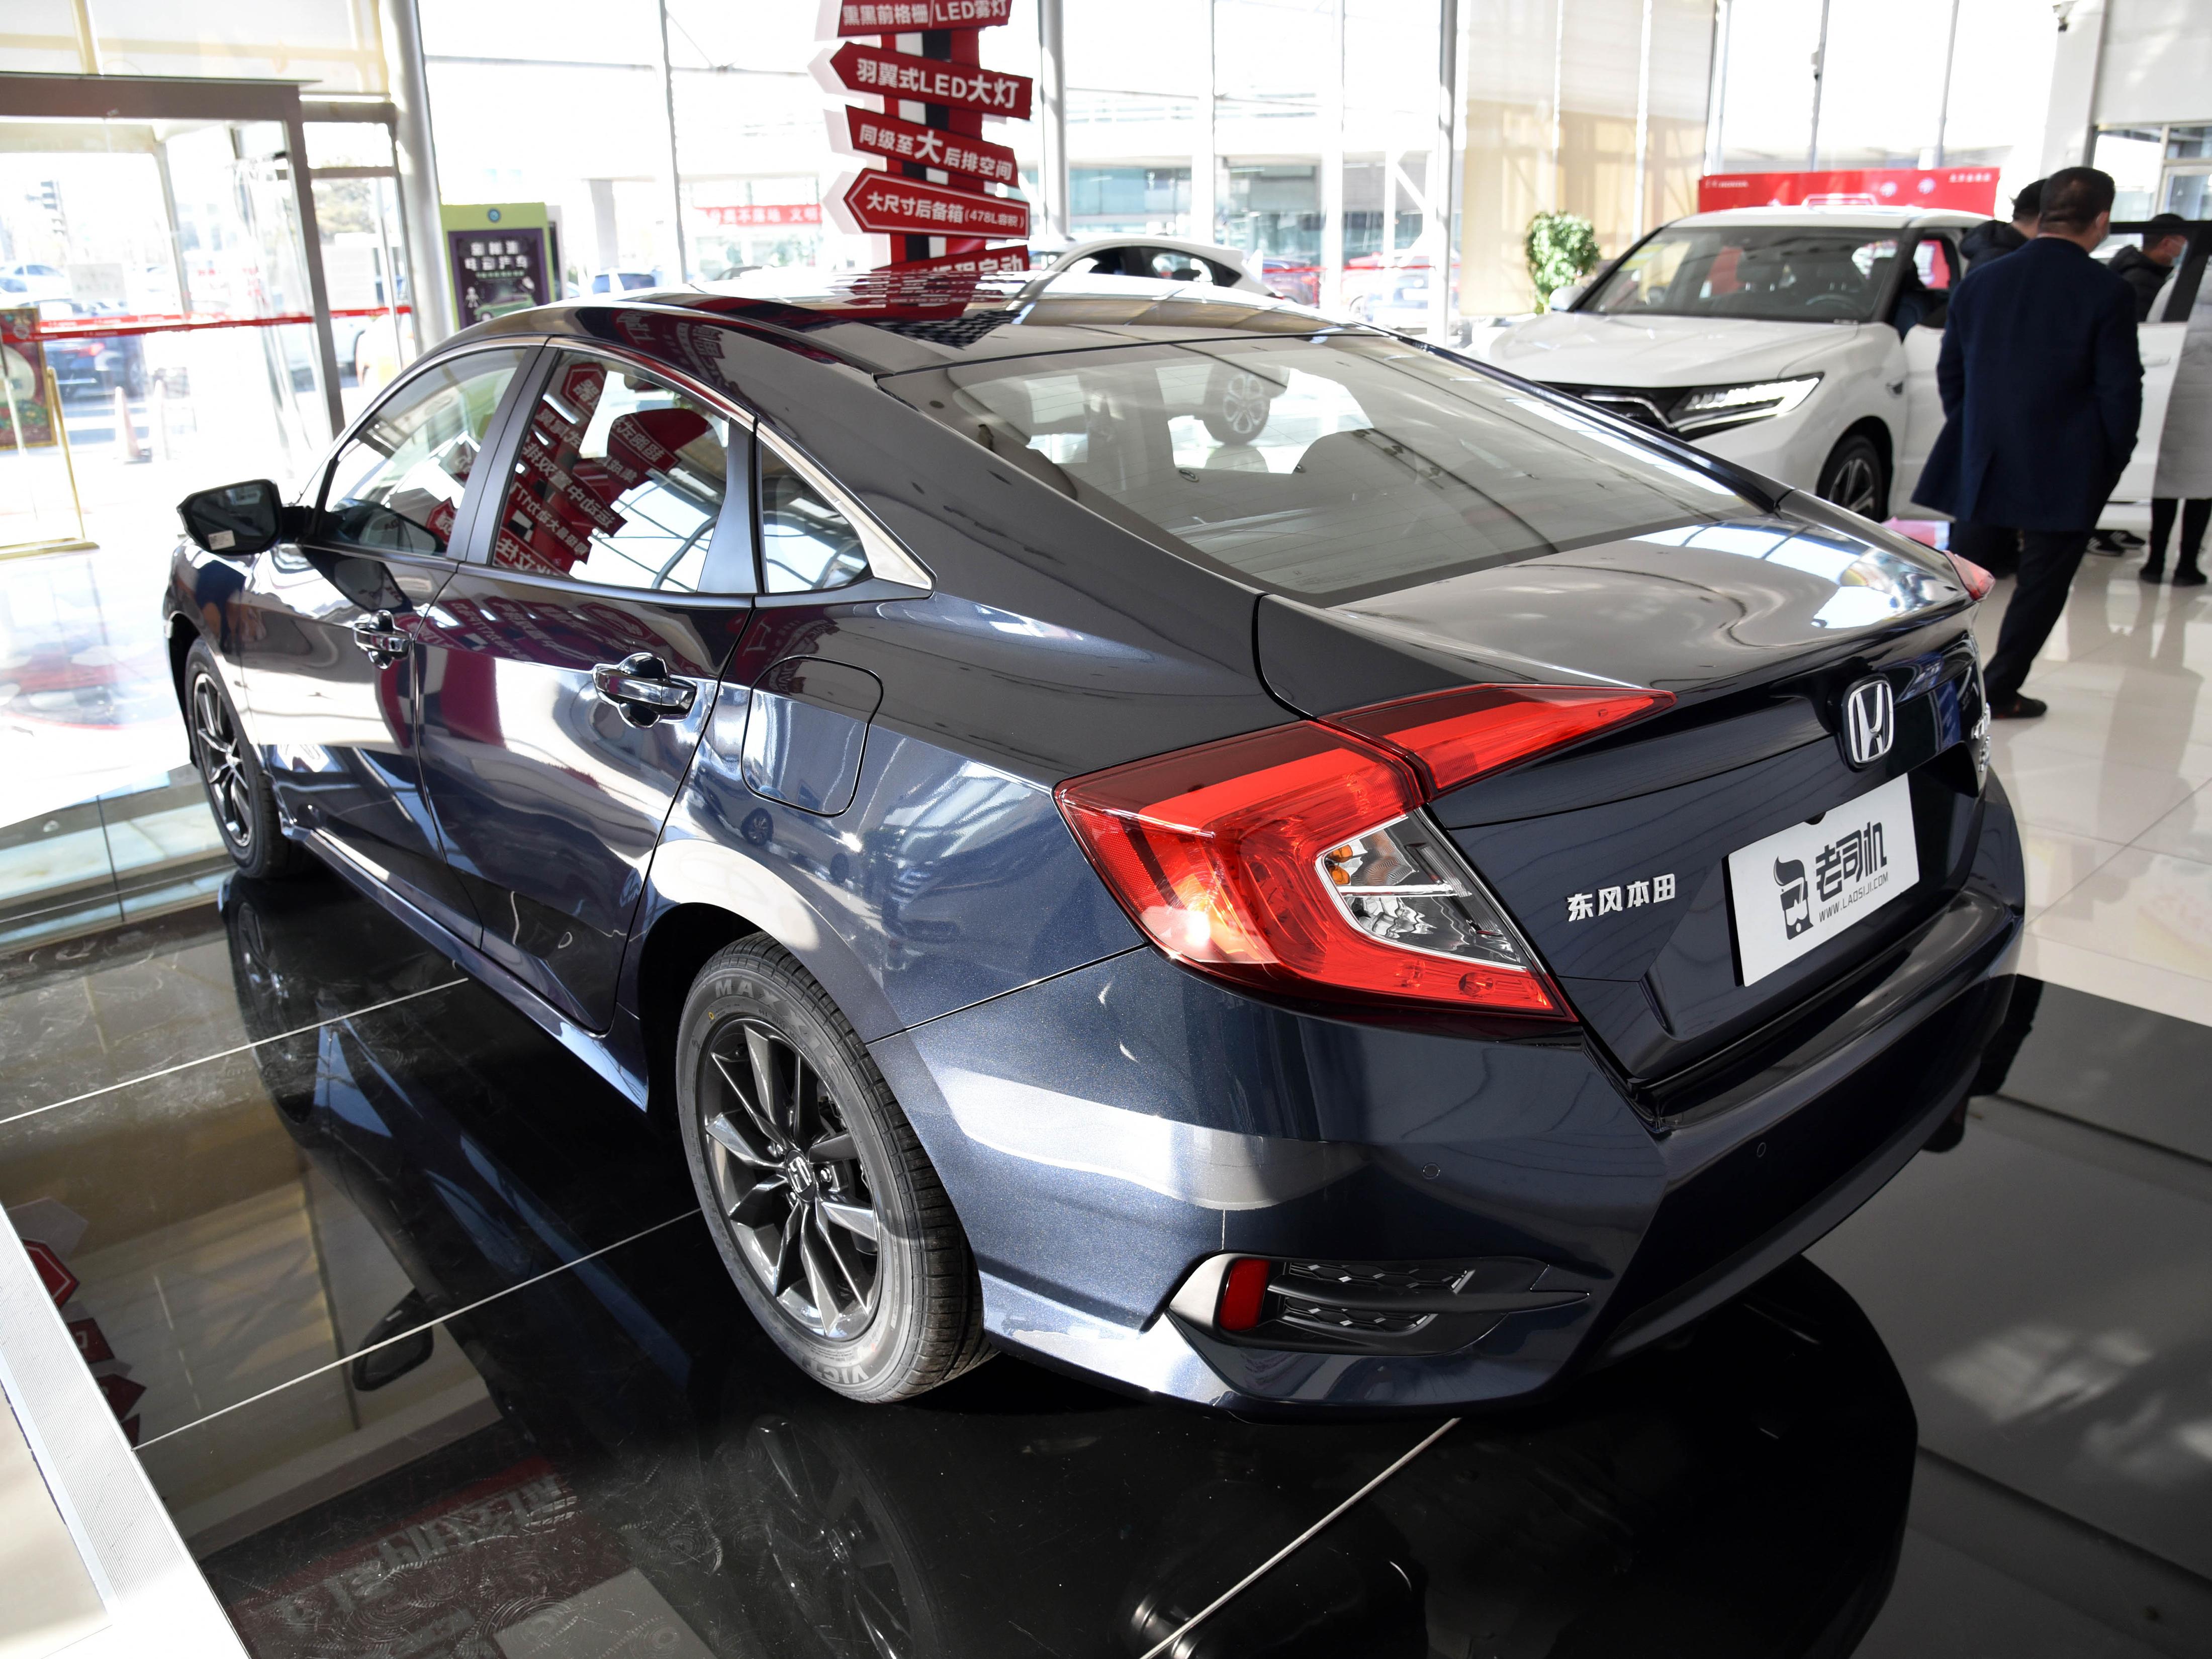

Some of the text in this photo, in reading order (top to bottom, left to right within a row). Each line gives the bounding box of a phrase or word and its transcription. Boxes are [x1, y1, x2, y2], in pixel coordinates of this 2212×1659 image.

[856, 57, 1019, 109] 羽翼式LED大灯
[859, 124, 1013, 180] 同级至大后排空间
[1815, 821, 1887, 902] 老司机
[1567, 873, 1675, 921] 东风本田
[1819, 872, 1889, 922] WWW.LAOSIJI.COM
[715, 978, 844, 1085] MAXXIS
